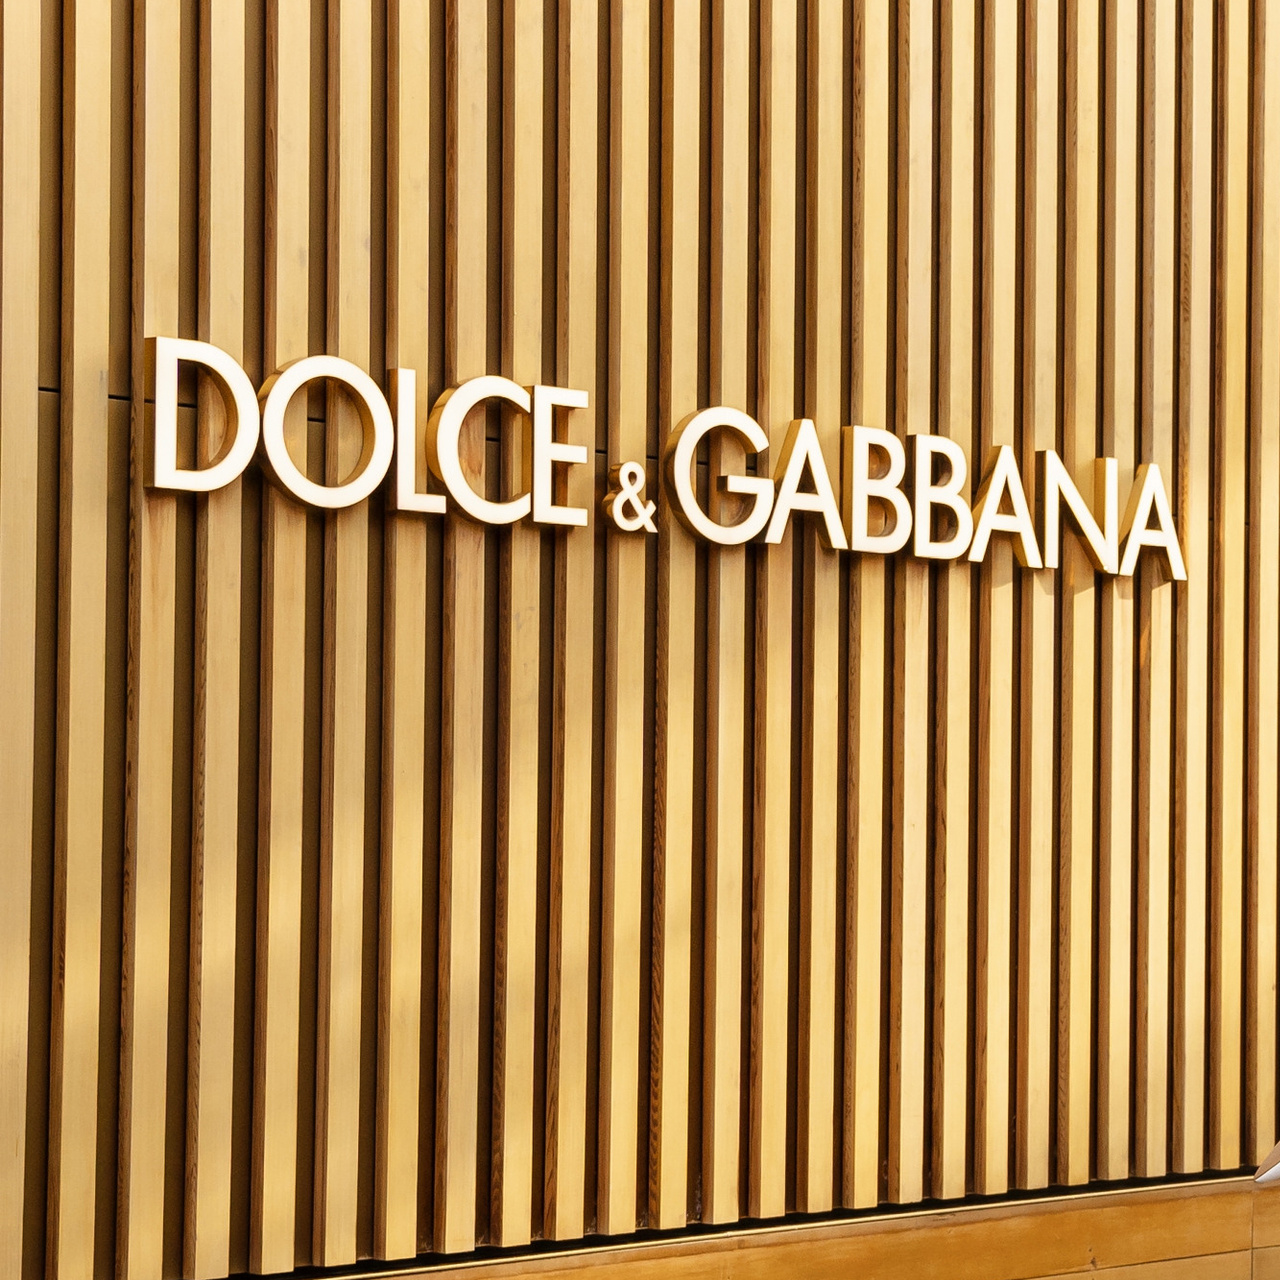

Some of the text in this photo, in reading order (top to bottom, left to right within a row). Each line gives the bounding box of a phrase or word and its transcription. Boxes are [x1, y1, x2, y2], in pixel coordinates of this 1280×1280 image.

[150, 336, 1187, 581] DOLCE & GABBANA
